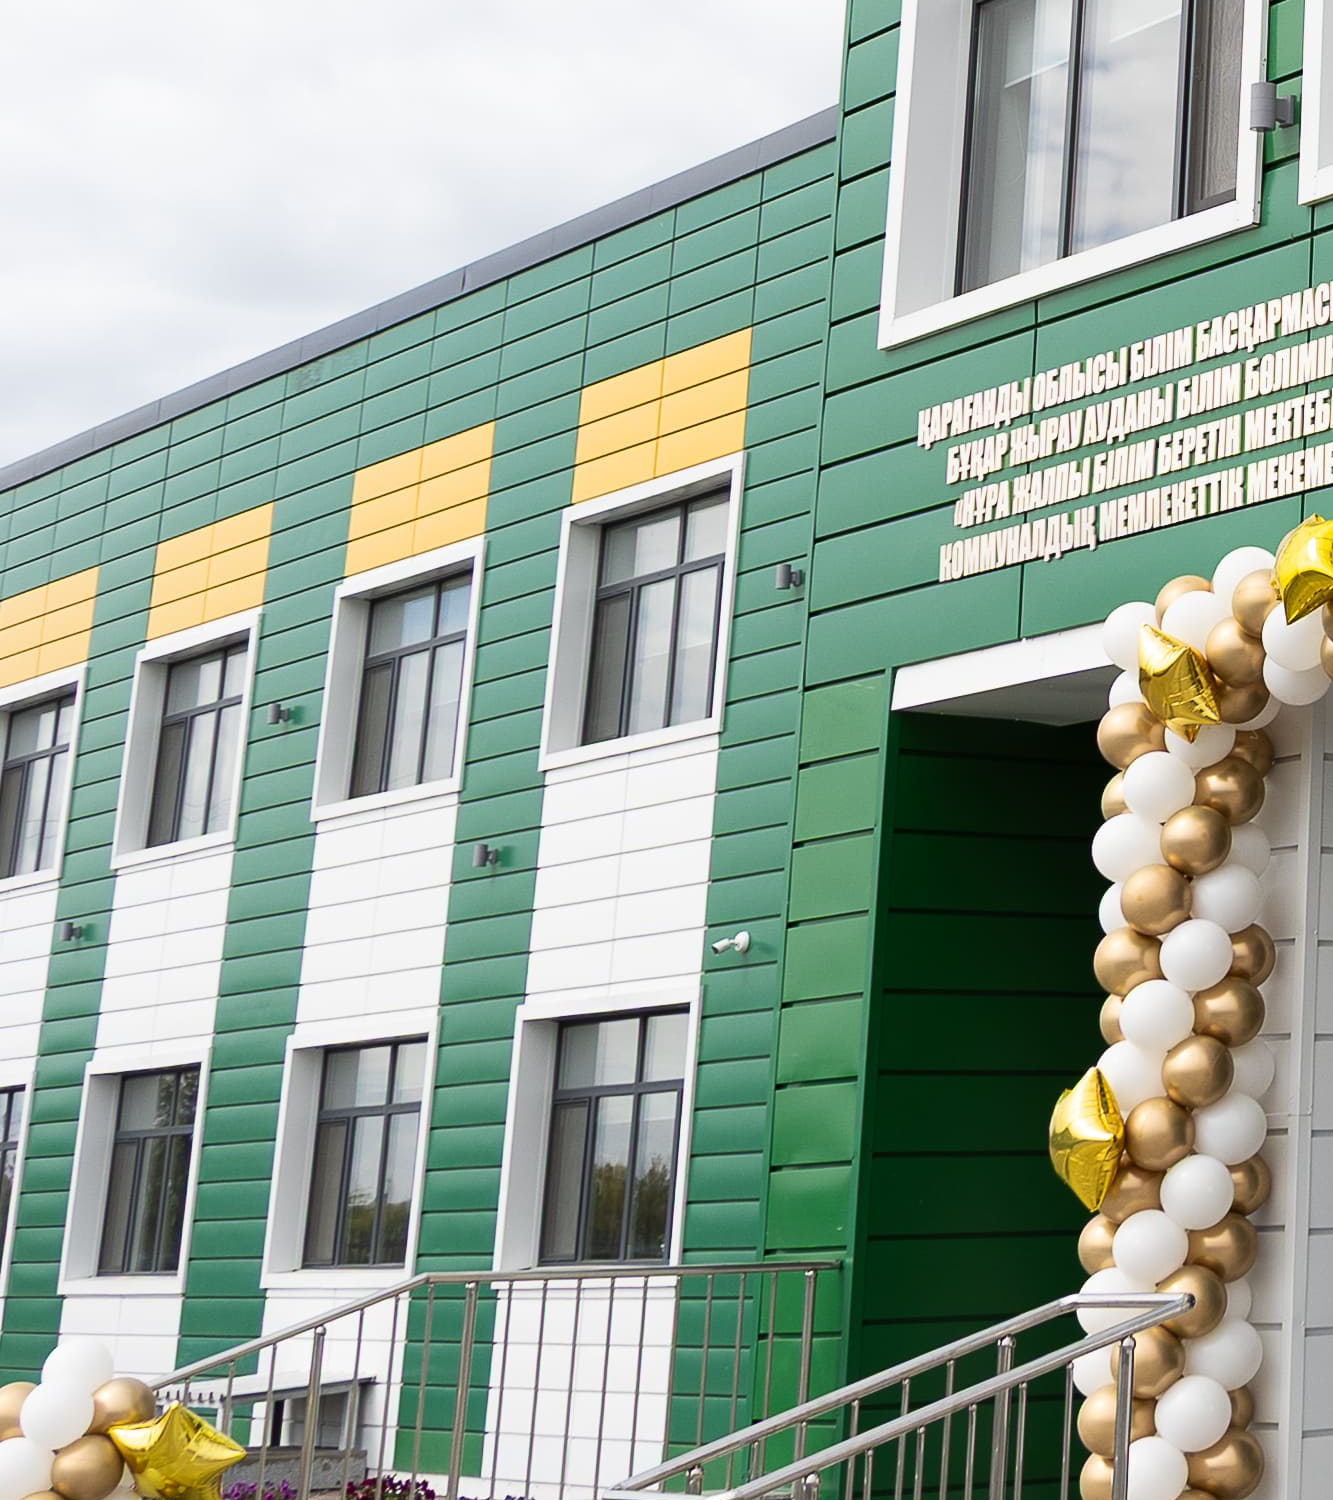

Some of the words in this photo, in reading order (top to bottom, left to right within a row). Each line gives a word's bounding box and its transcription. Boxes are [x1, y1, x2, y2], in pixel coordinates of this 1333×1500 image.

[917, 378, 1031, 450] ҚАРАҒАНДЫ
[1033, 347, 1128, 411] ОБЛЫСЫ
[1130, 326, 1193, 382] БІЛІМ
[1009, 410, 1082, 467] ЖЫРАУ
[1082, 383, 1174, 446] АУДАНЫ
[1177, 362, 1242, 419] БІЛІМ
[1012, 457, 1090, 514] ЖАЛПЫ
[1092, 439, 1156, 493] БІЛІМ
[1157, 414, 1242, 475] БЕРЕТІН
[939, 506, 1097, 582] КОММУНАЛДЫҚ
[1099, 466, 1245, 542] МЕМЛЕКЕТТІК
